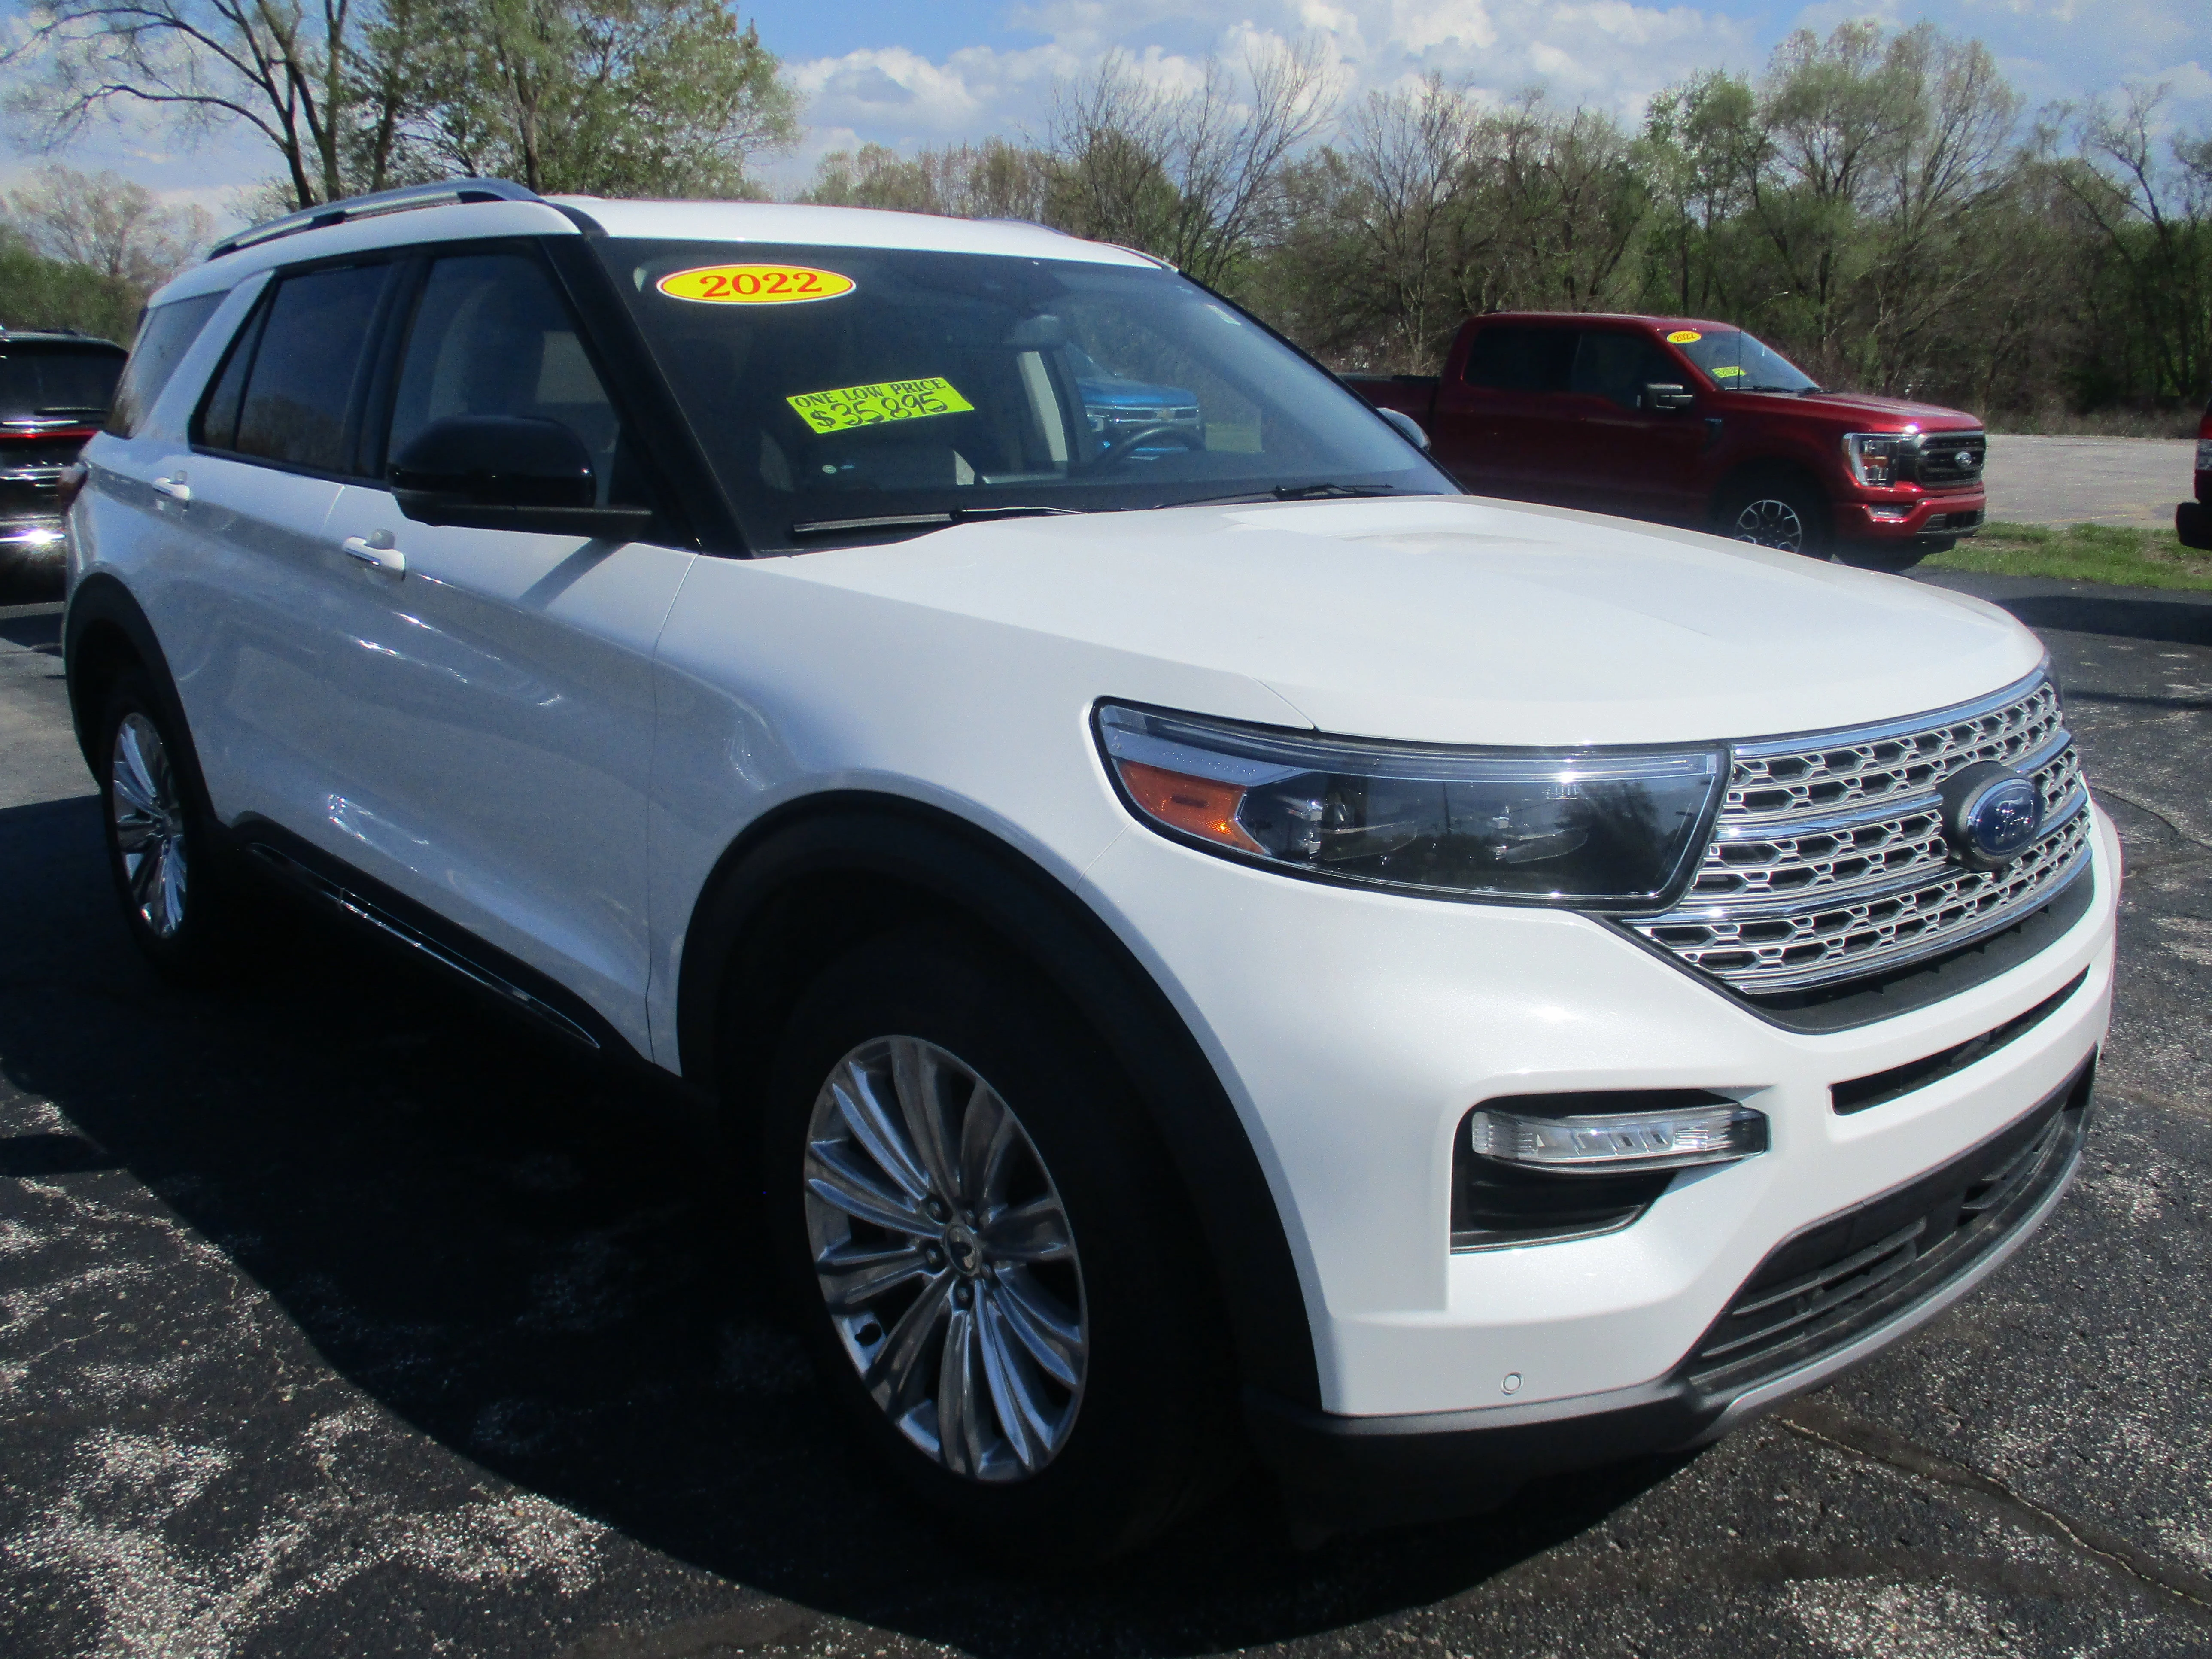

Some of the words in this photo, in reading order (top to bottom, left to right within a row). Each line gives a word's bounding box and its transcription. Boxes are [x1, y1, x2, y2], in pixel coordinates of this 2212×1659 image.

[699, 272, 823, 297] 2022
[1674, 333, 1696, 342] 2022
[795, 392, 838, 408] ONE
[841, 386, 884, 401] LOW
[888, 378, 946, 395] PRICE
